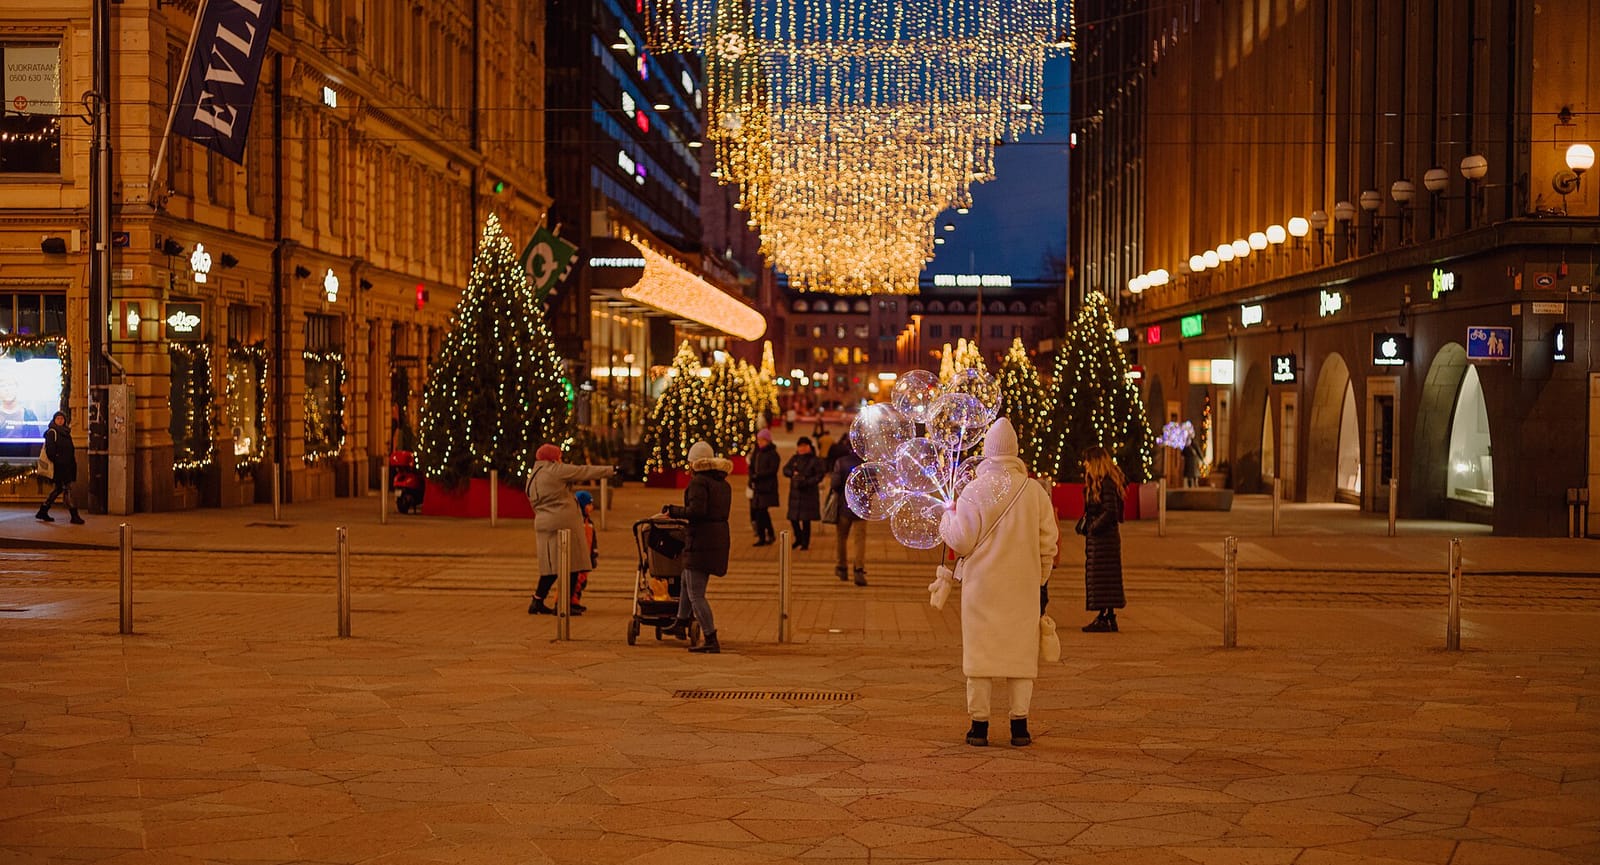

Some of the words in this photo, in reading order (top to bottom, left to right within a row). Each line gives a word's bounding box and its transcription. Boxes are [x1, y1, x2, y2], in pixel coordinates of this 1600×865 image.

[8, 63, 56, 71] VUOKRATAAN
[9, 74, 26, 82] 0500
[28, 74, 41, 82] 630
